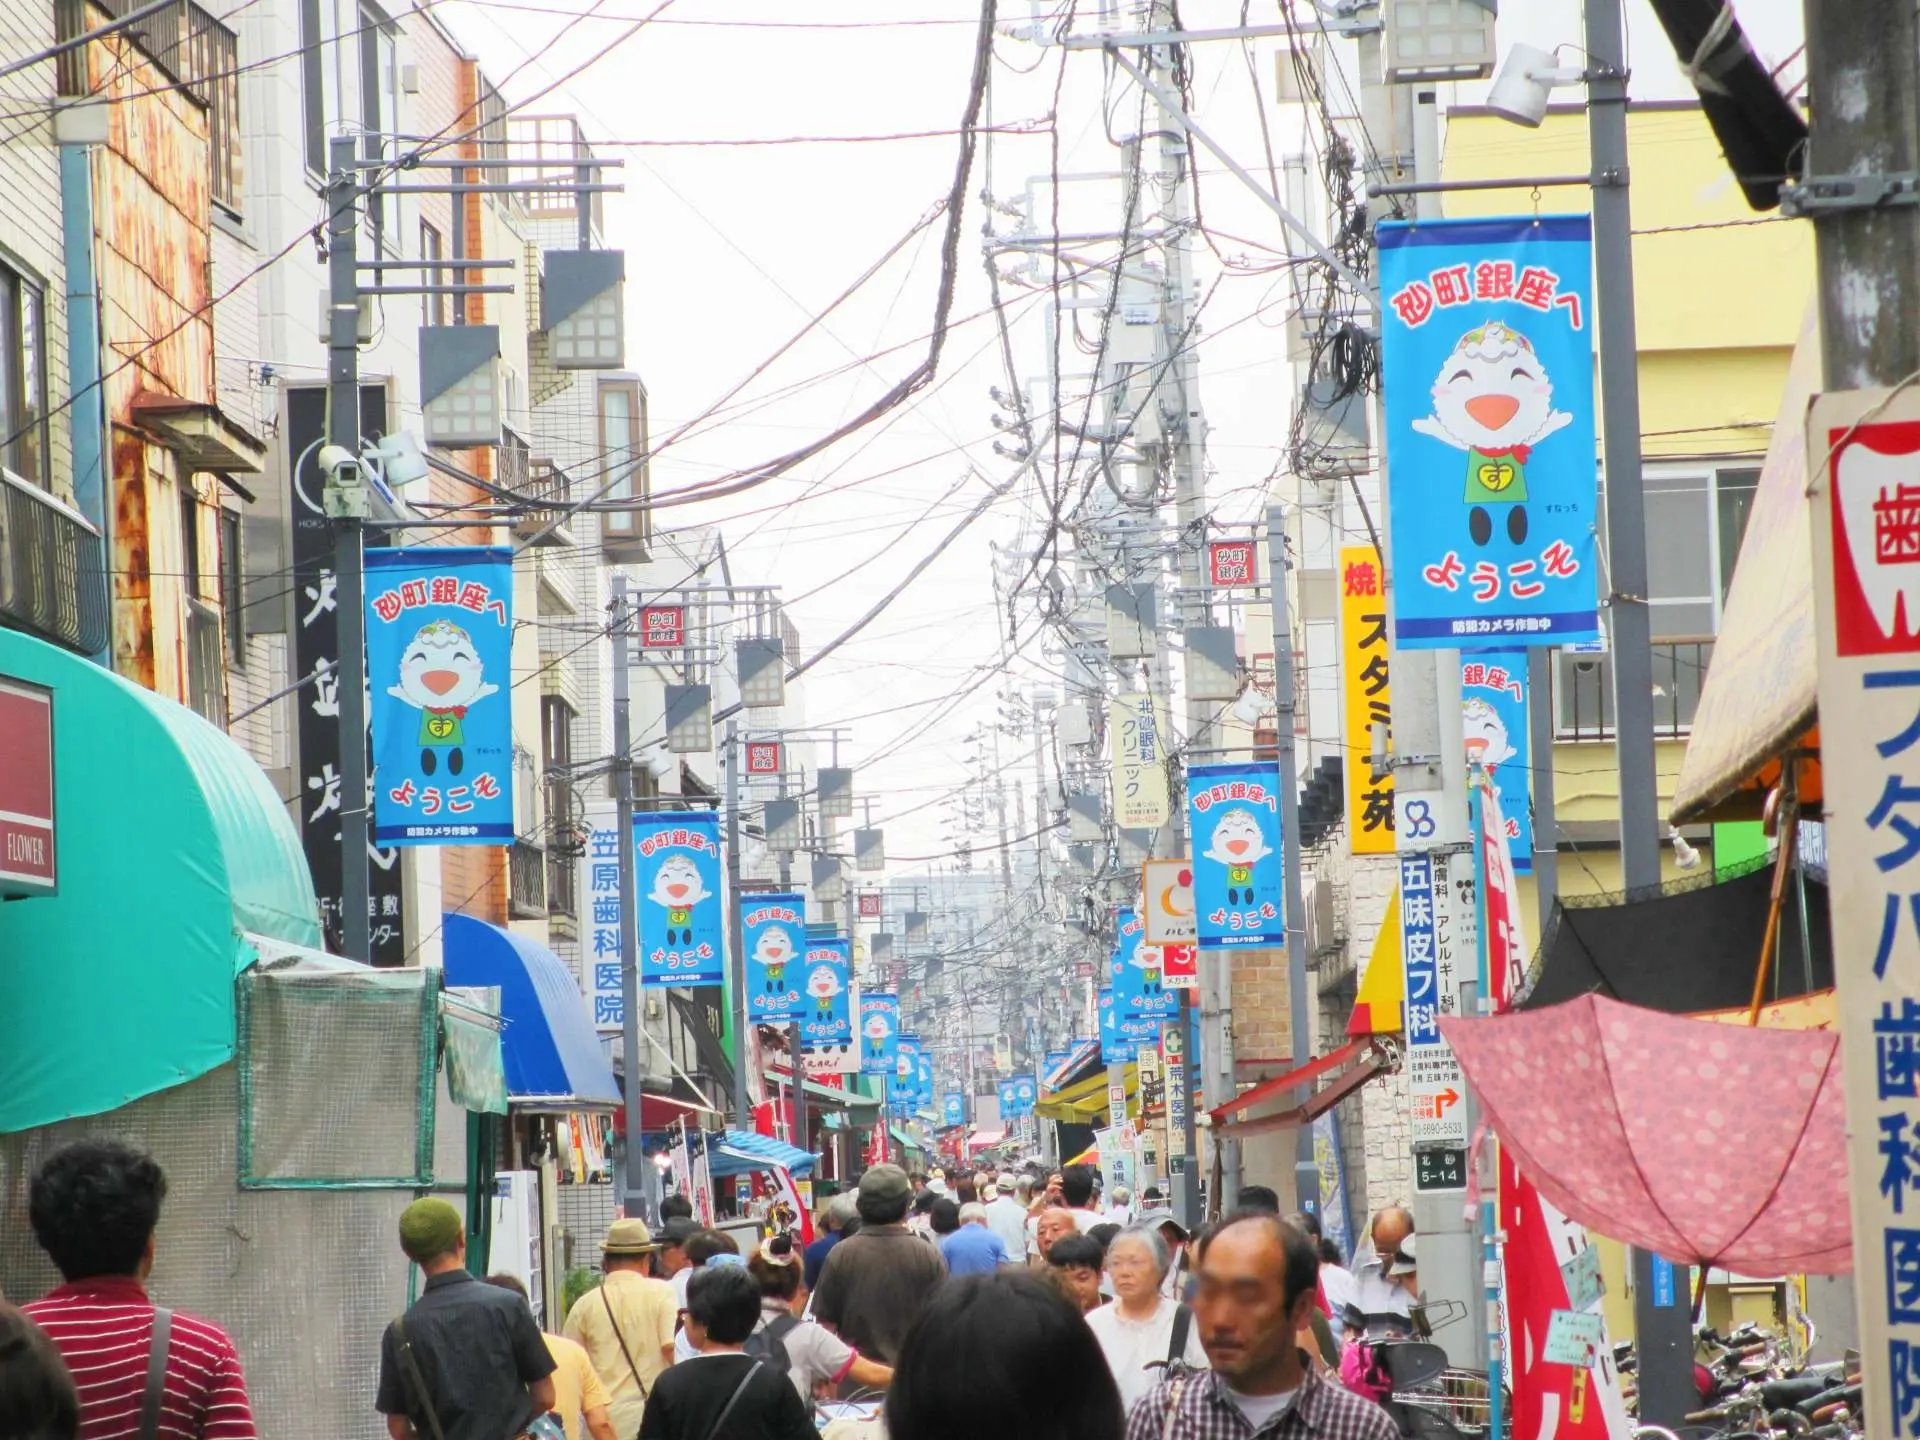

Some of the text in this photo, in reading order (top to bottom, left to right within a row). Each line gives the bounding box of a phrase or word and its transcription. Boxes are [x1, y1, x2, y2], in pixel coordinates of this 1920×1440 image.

[1391, 261, 1582, 329] 砂町銀座へ
[1344, 561, 1385, 598] 焼
[1424, 541, 1579, 601] ようこそ
[373, 577, 507, 625] 砂町銀座へ
[1121, 720, 1140, 798] クリニック
[391, 774, 500, 814] ようこそ
[1195, 783, 1276, 812] 砂町銀座へ
[7, 832, 45, 865] FLOWER
[640, 830, 717, 857] 砂町銀座へ
[590, 829, 626, 1025] 笠原歯科医院
[1210, 903, 1276, 929] ようこそ
[651, 944, 713, 969] ようこそ
[1403, 860, 1438, 1038] 五味皮フ科
[1421, 1171, 1457, 1182] 5-14
